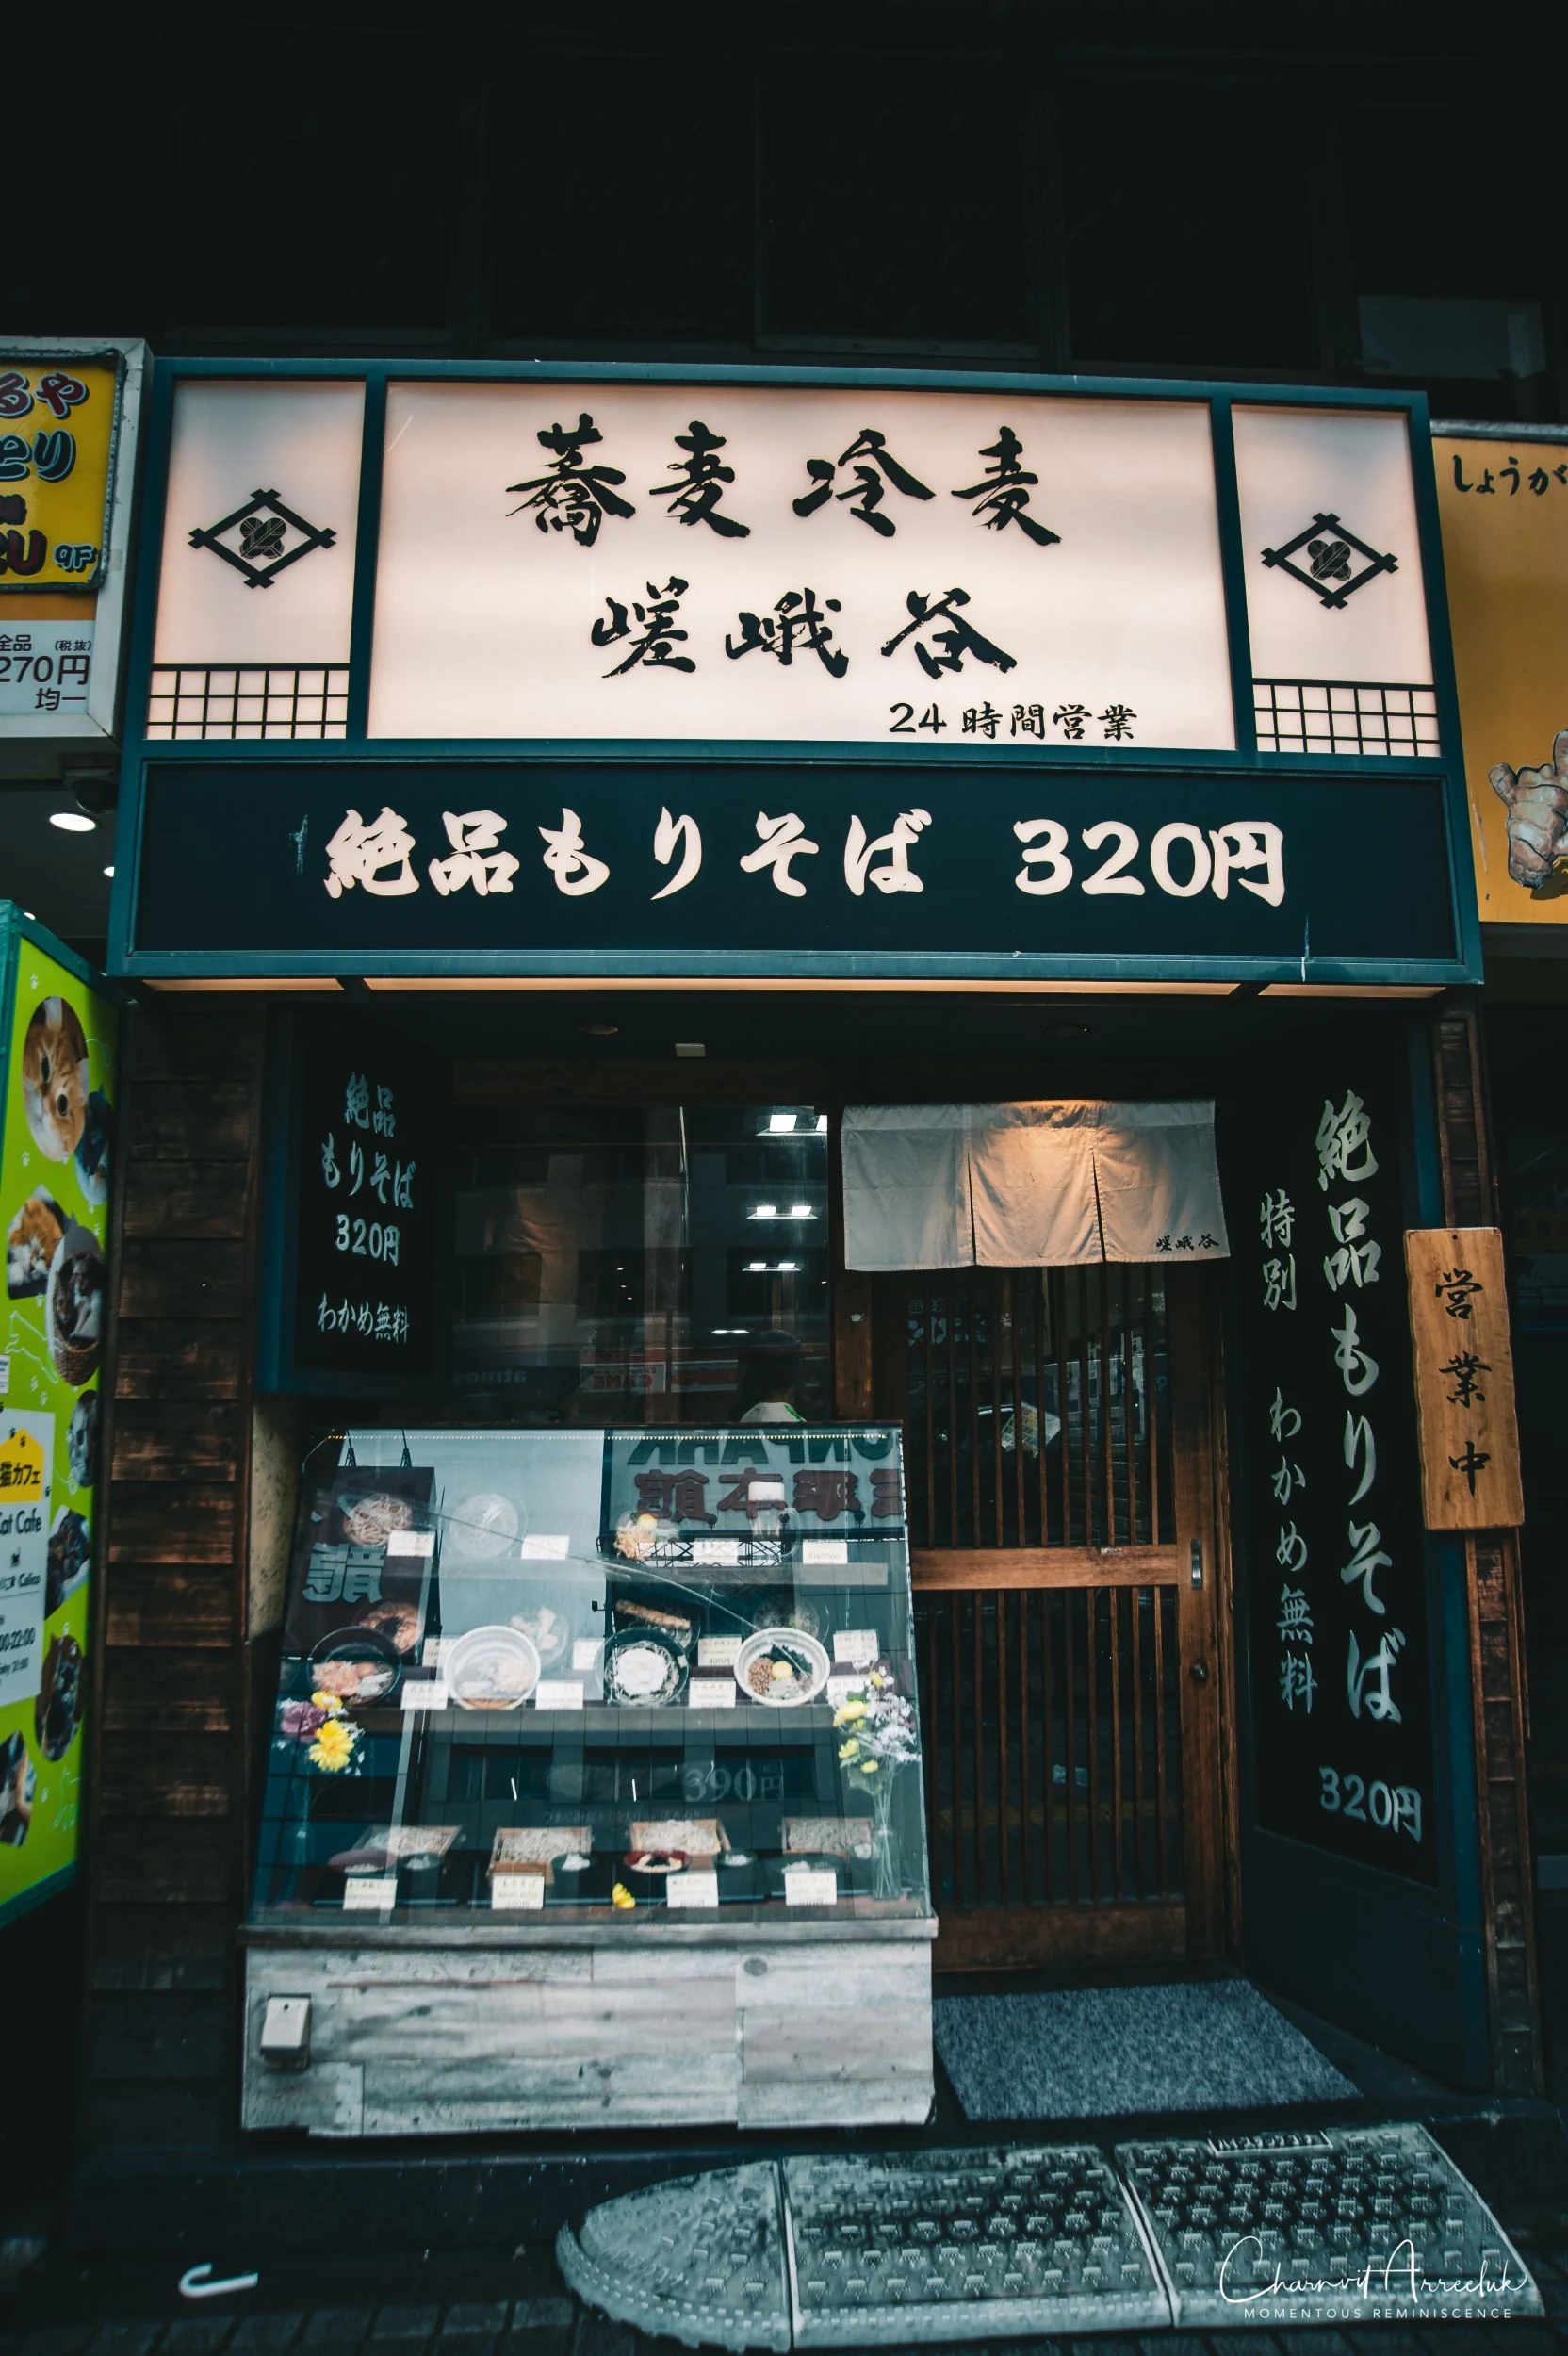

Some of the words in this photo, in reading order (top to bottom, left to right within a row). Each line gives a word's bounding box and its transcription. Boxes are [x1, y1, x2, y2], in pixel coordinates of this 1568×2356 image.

[590, 575, 1018, 680] 嵯峨谷
[34, 687, 87, 712] 均一
[324, 806, 933, 901] 絶品もりそば
[1013, 818, 1285, 907] 320円
[320, 1131, 417, 1209] もりそば
[335, 1213, 400, 1267] 320円
[1156, 1233, 1220, 1252] 嵯峨谷
[317, 1291, 411, 1344] わかめ無料
[1315, 1088, 1406, 1725] 絶品もりそば
[1434, 1268, 1494, 1498] 営業中
[0, 1512, 14, 1535] at
[16, 1507, 42, 1534] Cafe
[1319, 1765, 1422, 1843] 320円
